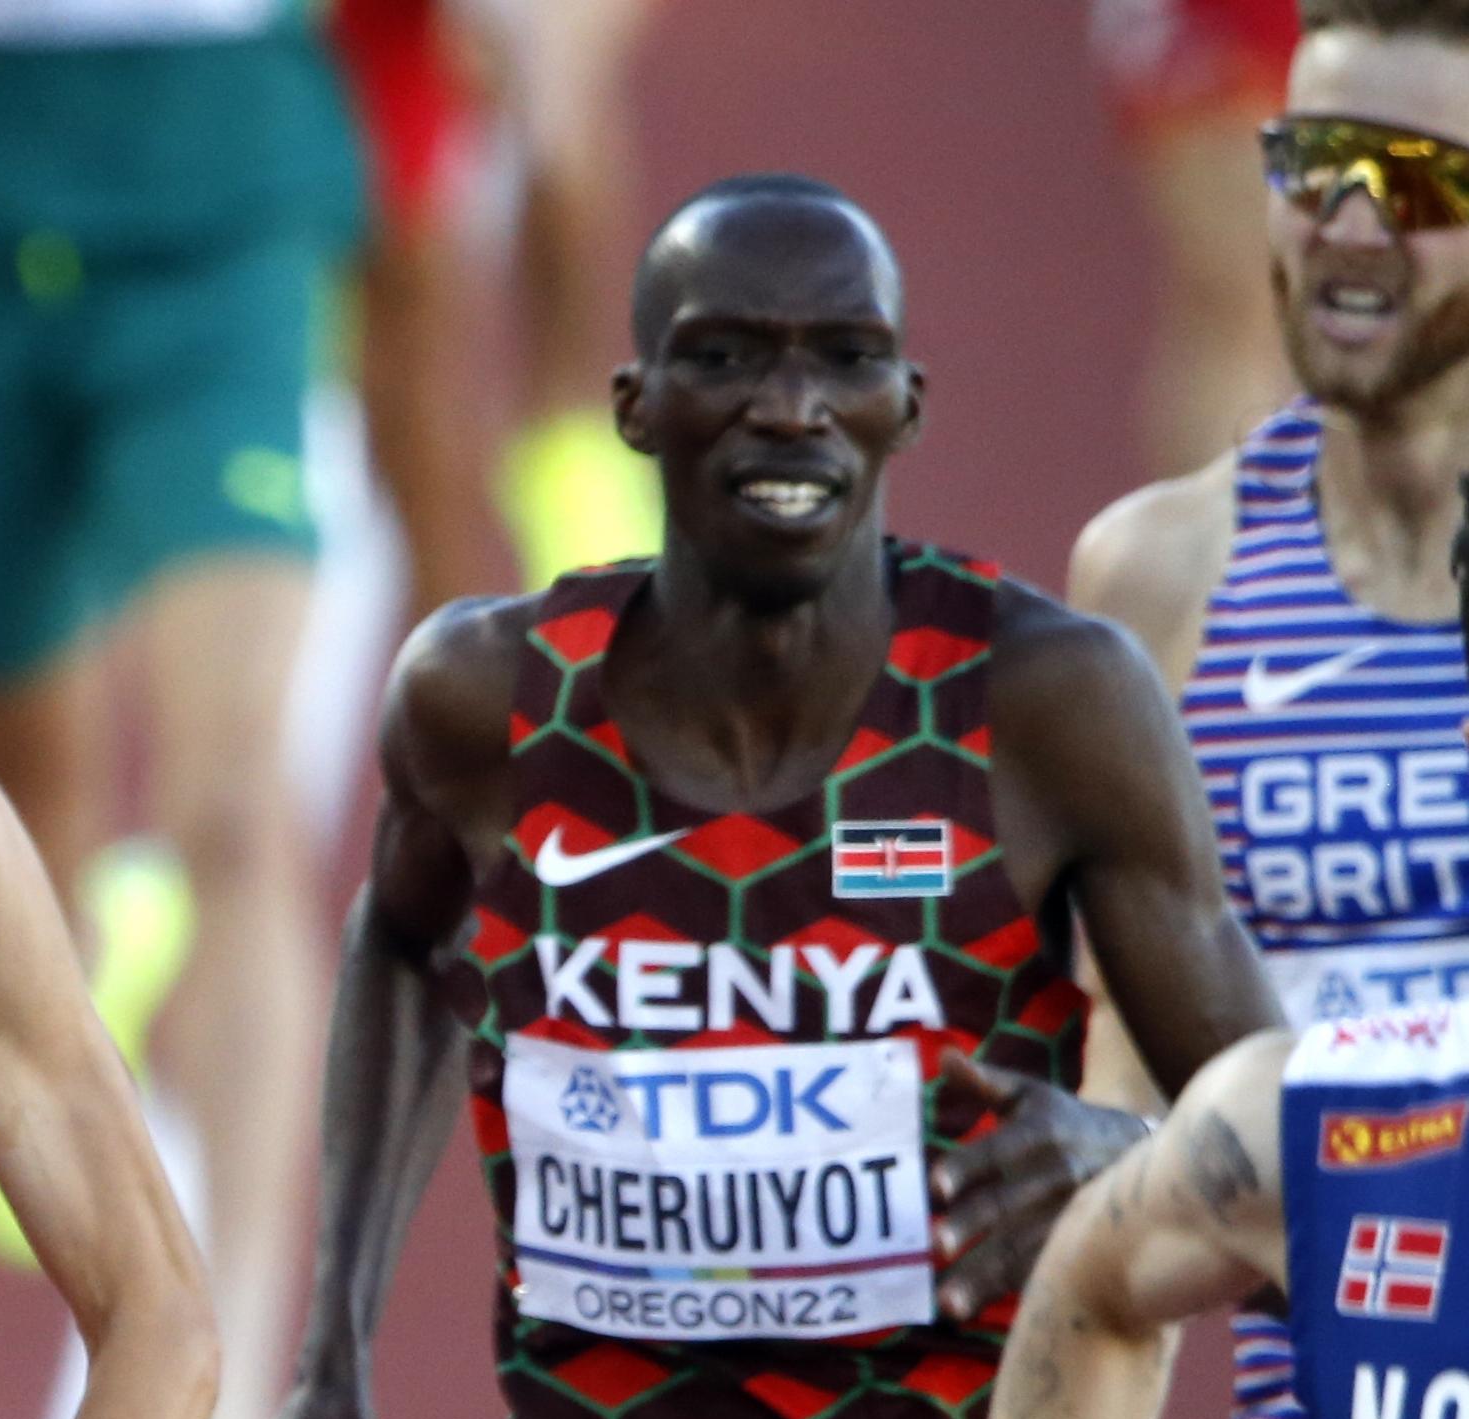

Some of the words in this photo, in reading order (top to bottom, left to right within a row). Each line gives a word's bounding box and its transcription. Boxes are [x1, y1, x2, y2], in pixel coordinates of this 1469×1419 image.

[534, 935, 943, 1032] KENYA
[617, 1066, 851, 1141] TDK
[537, 1156, 897, 1254] CHERUIYOT
[573, 1284, 857, 1328] OREGON22
